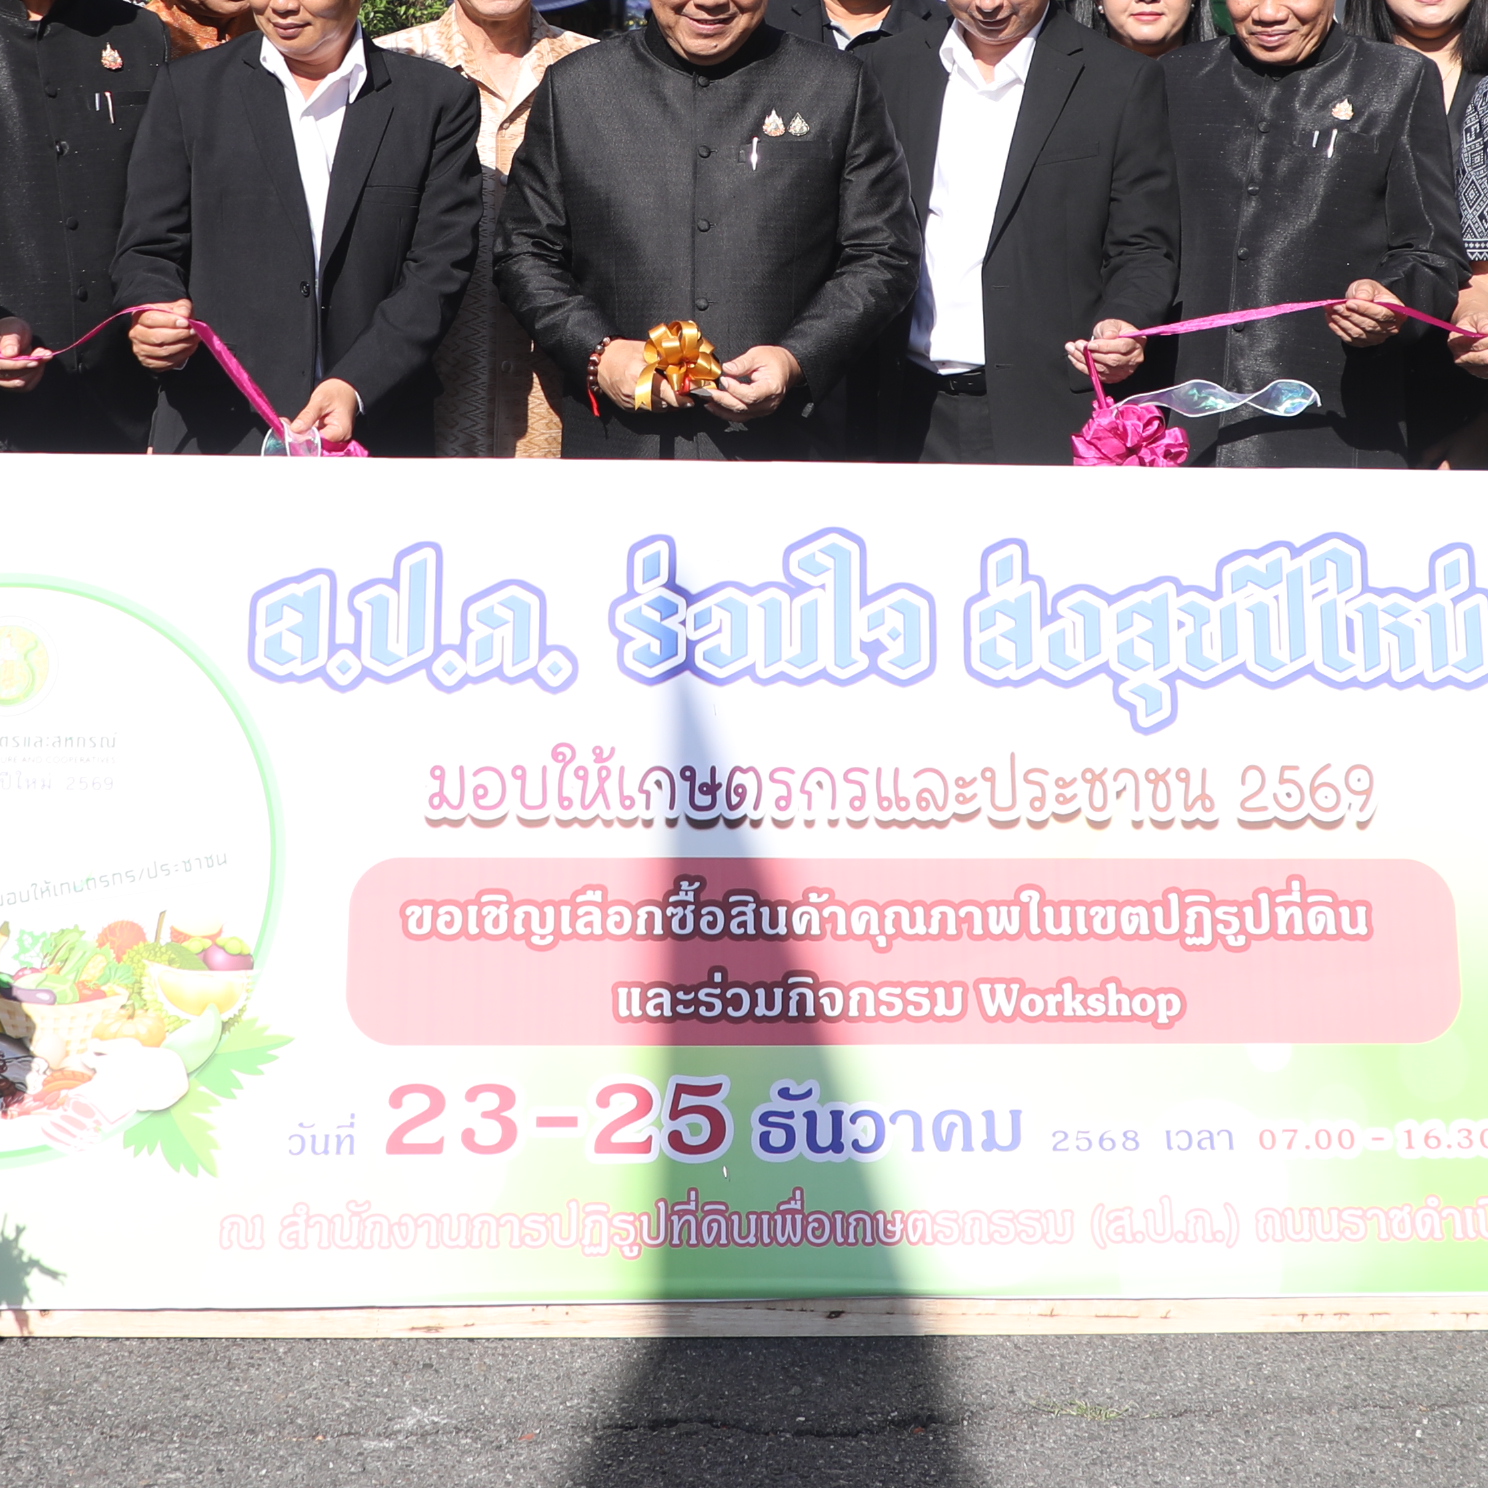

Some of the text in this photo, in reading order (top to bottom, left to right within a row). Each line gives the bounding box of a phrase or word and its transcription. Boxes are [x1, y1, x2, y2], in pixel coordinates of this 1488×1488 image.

[609, 527, 936, 688] ร่วมใจ
[65, 776, 115, 791] 2569
[426, 743, 1377, 822] มอบให้เกษตรกรและประชาชน 2569
[403, 877, 1370, 950] ขอเชิญเลือกซื้อสินค้าคุณภาพในเขตปฏิรูปที่ดิน
[614, 969, 1184, 1025] และร่วมกิจกรรม Workshop
[286, 1112, 356, 1157] วันที่
[756, 1084, 1023, 1156] ธันวาคม
[1050, 1128, 1142, 1153] 2568
[1164, 1127, 1236, 1153] เวลา
[219, 1208, 266, 1250] ณ
[278, 1187, 1073, 1260] สำนักงานการปฏิรูปที่ดินเพื่อเกษตรกรรม
